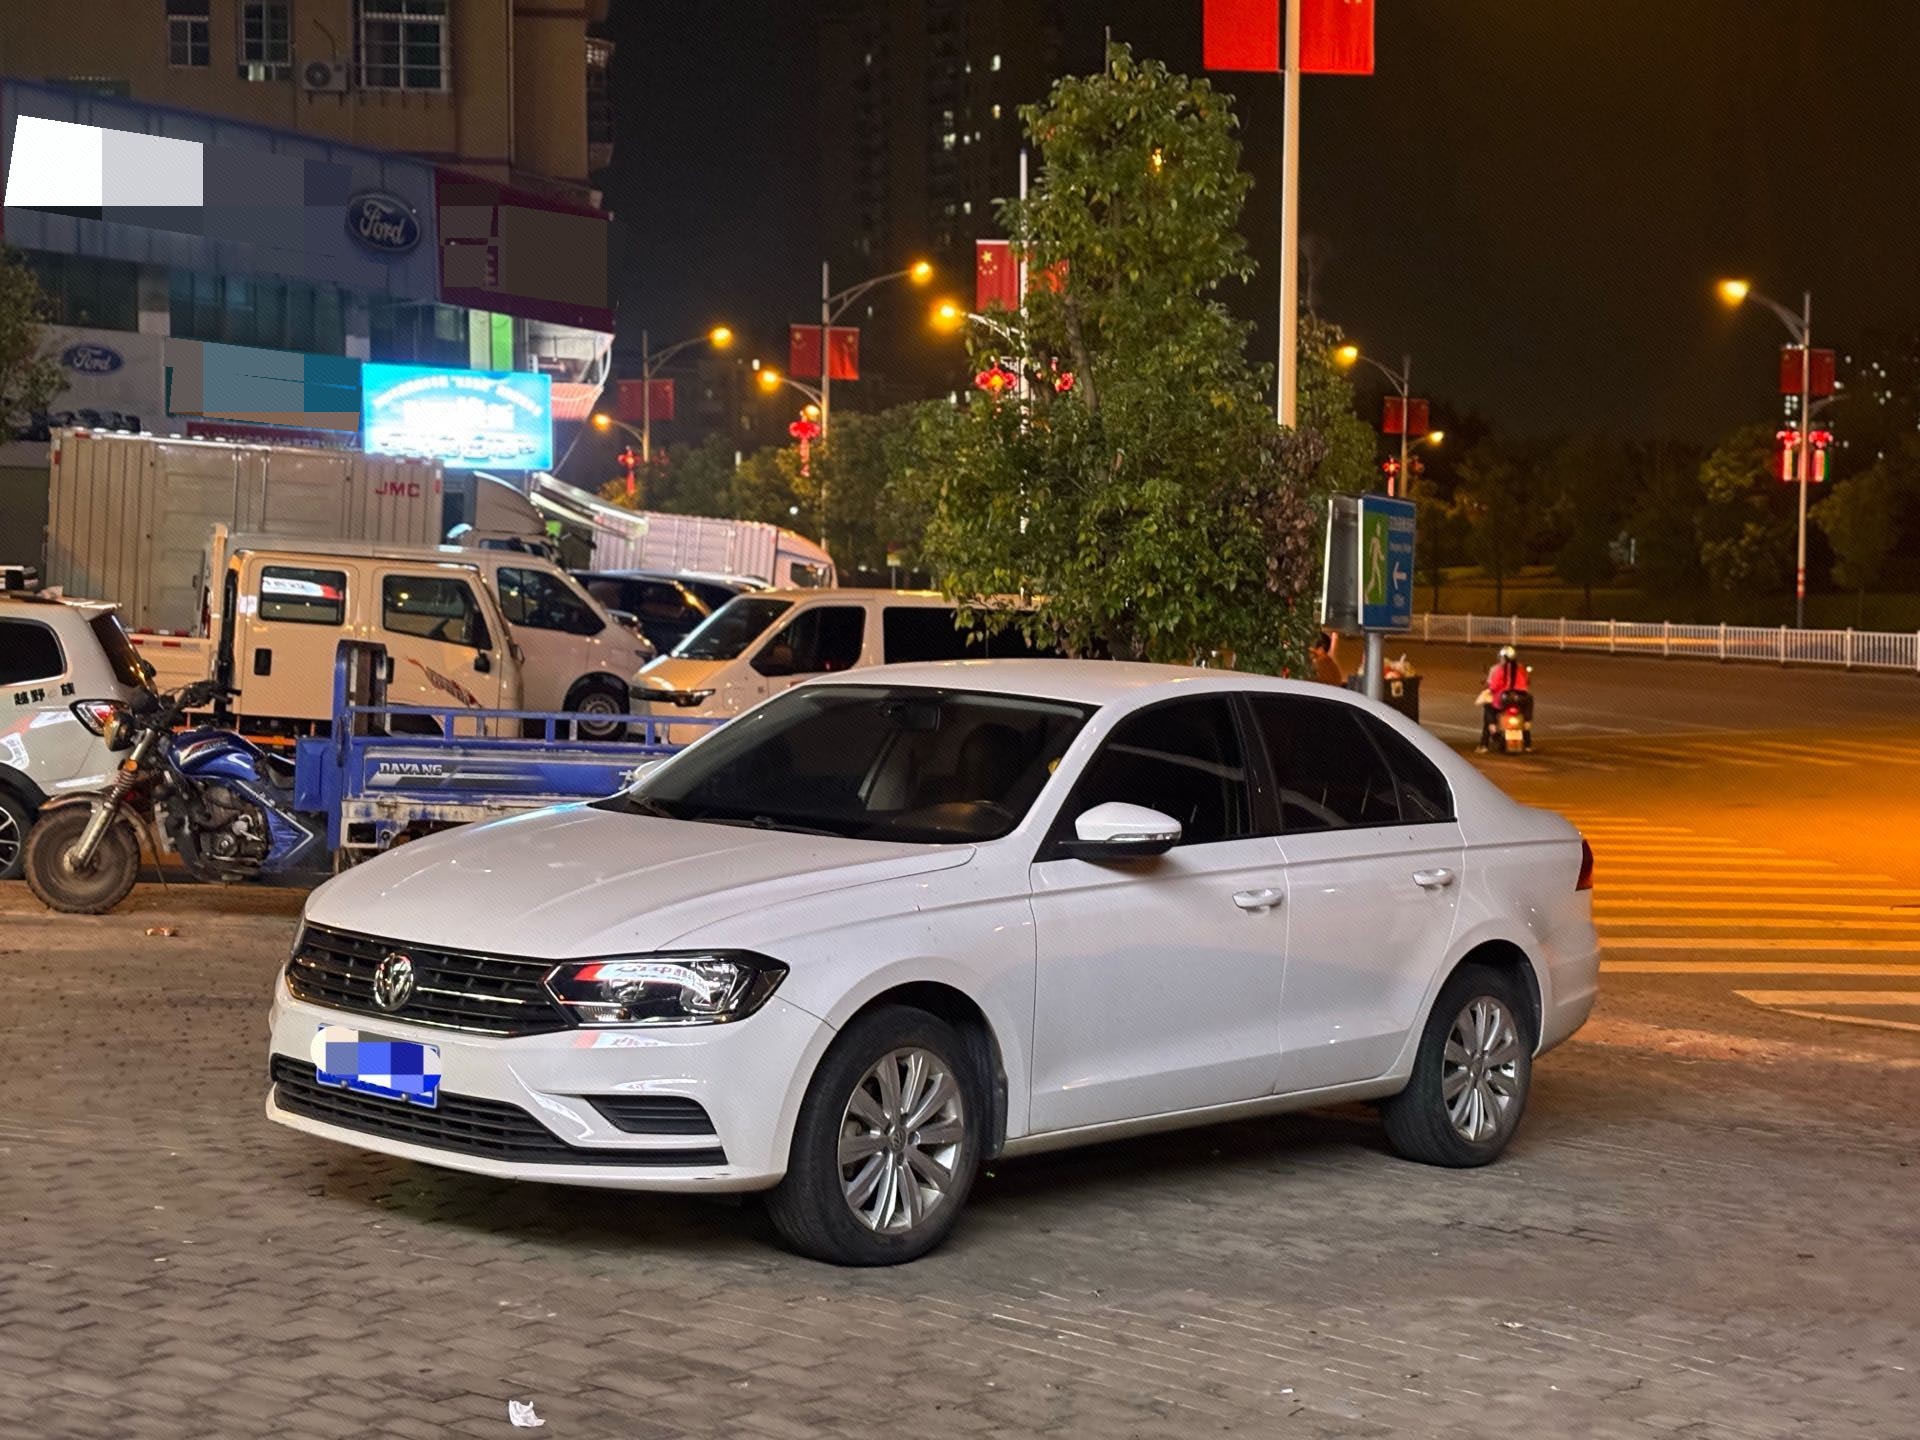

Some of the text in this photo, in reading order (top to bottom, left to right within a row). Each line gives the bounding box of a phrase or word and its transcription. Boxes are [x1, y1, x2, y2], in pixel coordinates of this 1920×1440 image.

[361, 199, 405, 244] Ford
[73, 347, 113, 371] Ford
[375, 481, 420, 497] JMC
[379, 762, 443, 776] DAYANG
